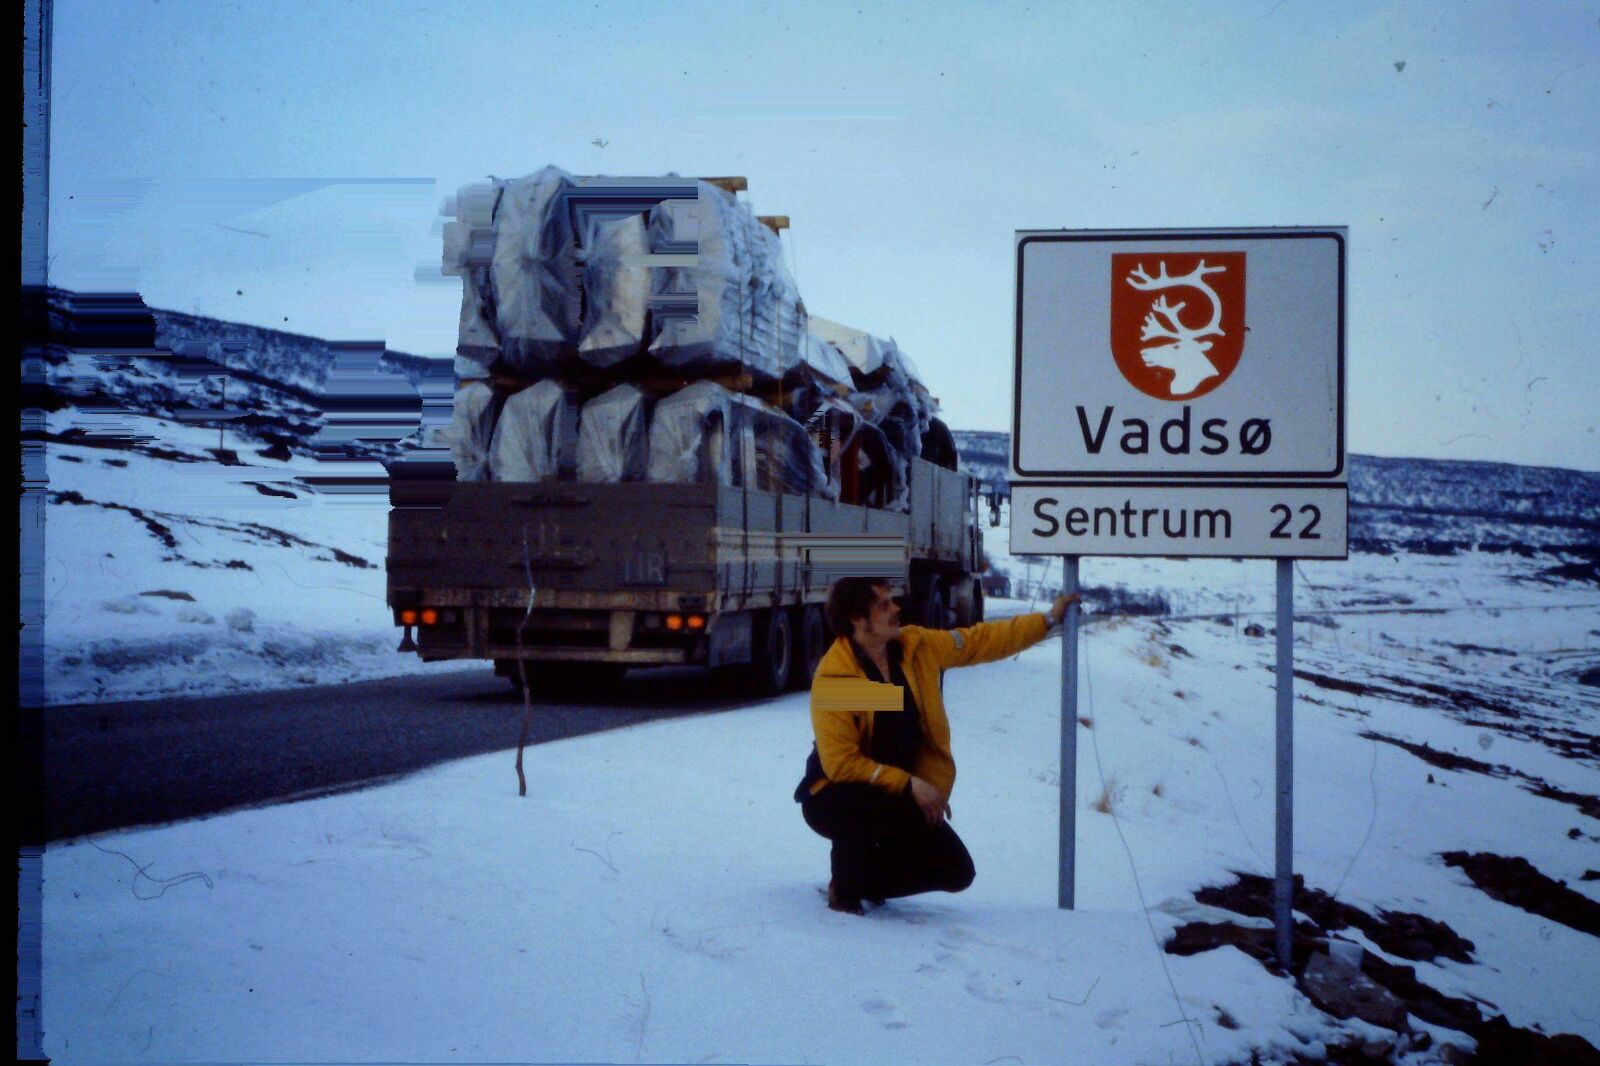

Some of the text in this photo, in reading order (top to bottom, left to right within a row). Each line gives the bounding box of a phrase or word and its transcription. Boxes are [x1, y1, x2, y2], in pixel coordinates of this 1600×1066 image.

[1075, 405, 1272, 455] Vadsø
[1031, 497, 1322, 539] Sentrum 22
